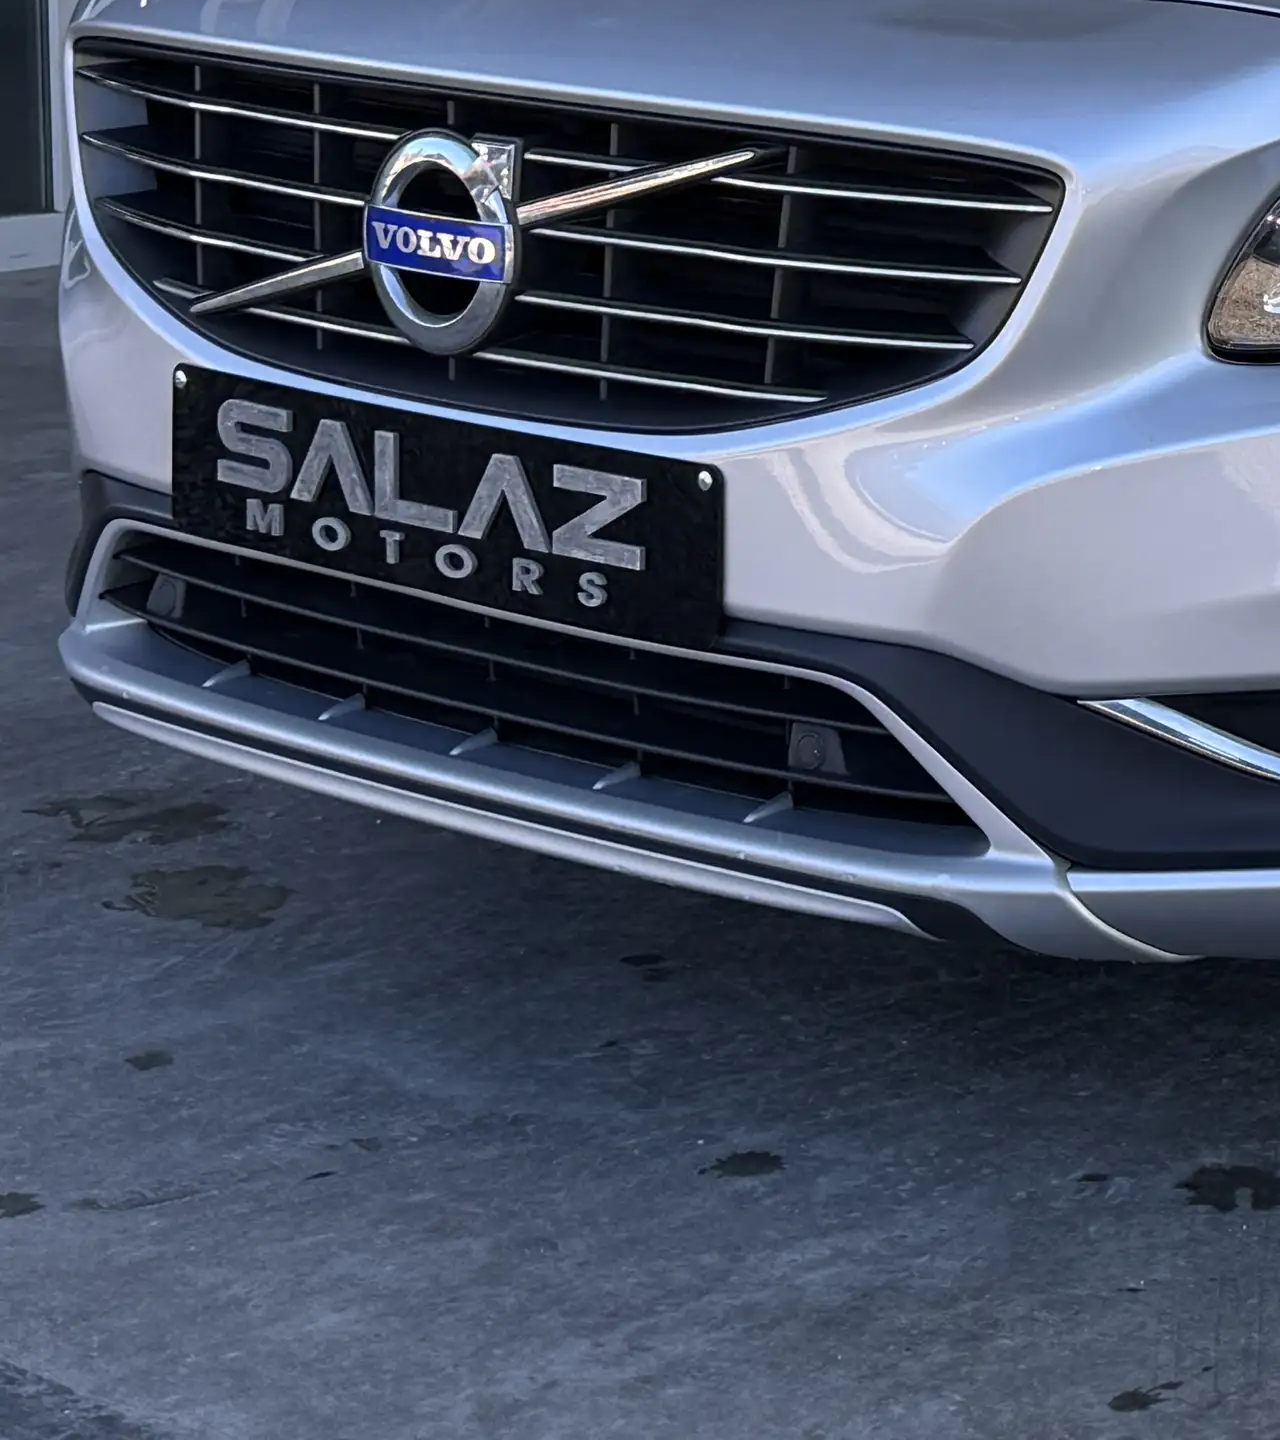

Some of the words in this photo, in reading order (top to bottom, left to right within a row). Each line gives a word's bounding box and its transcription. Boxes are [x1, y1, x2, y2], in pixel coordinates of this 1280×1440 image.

[372, 221, 497, 266] VOLVO
[216, 397, 648, 572] SALAZ
[245, 497, 608, 608] MOTORS
